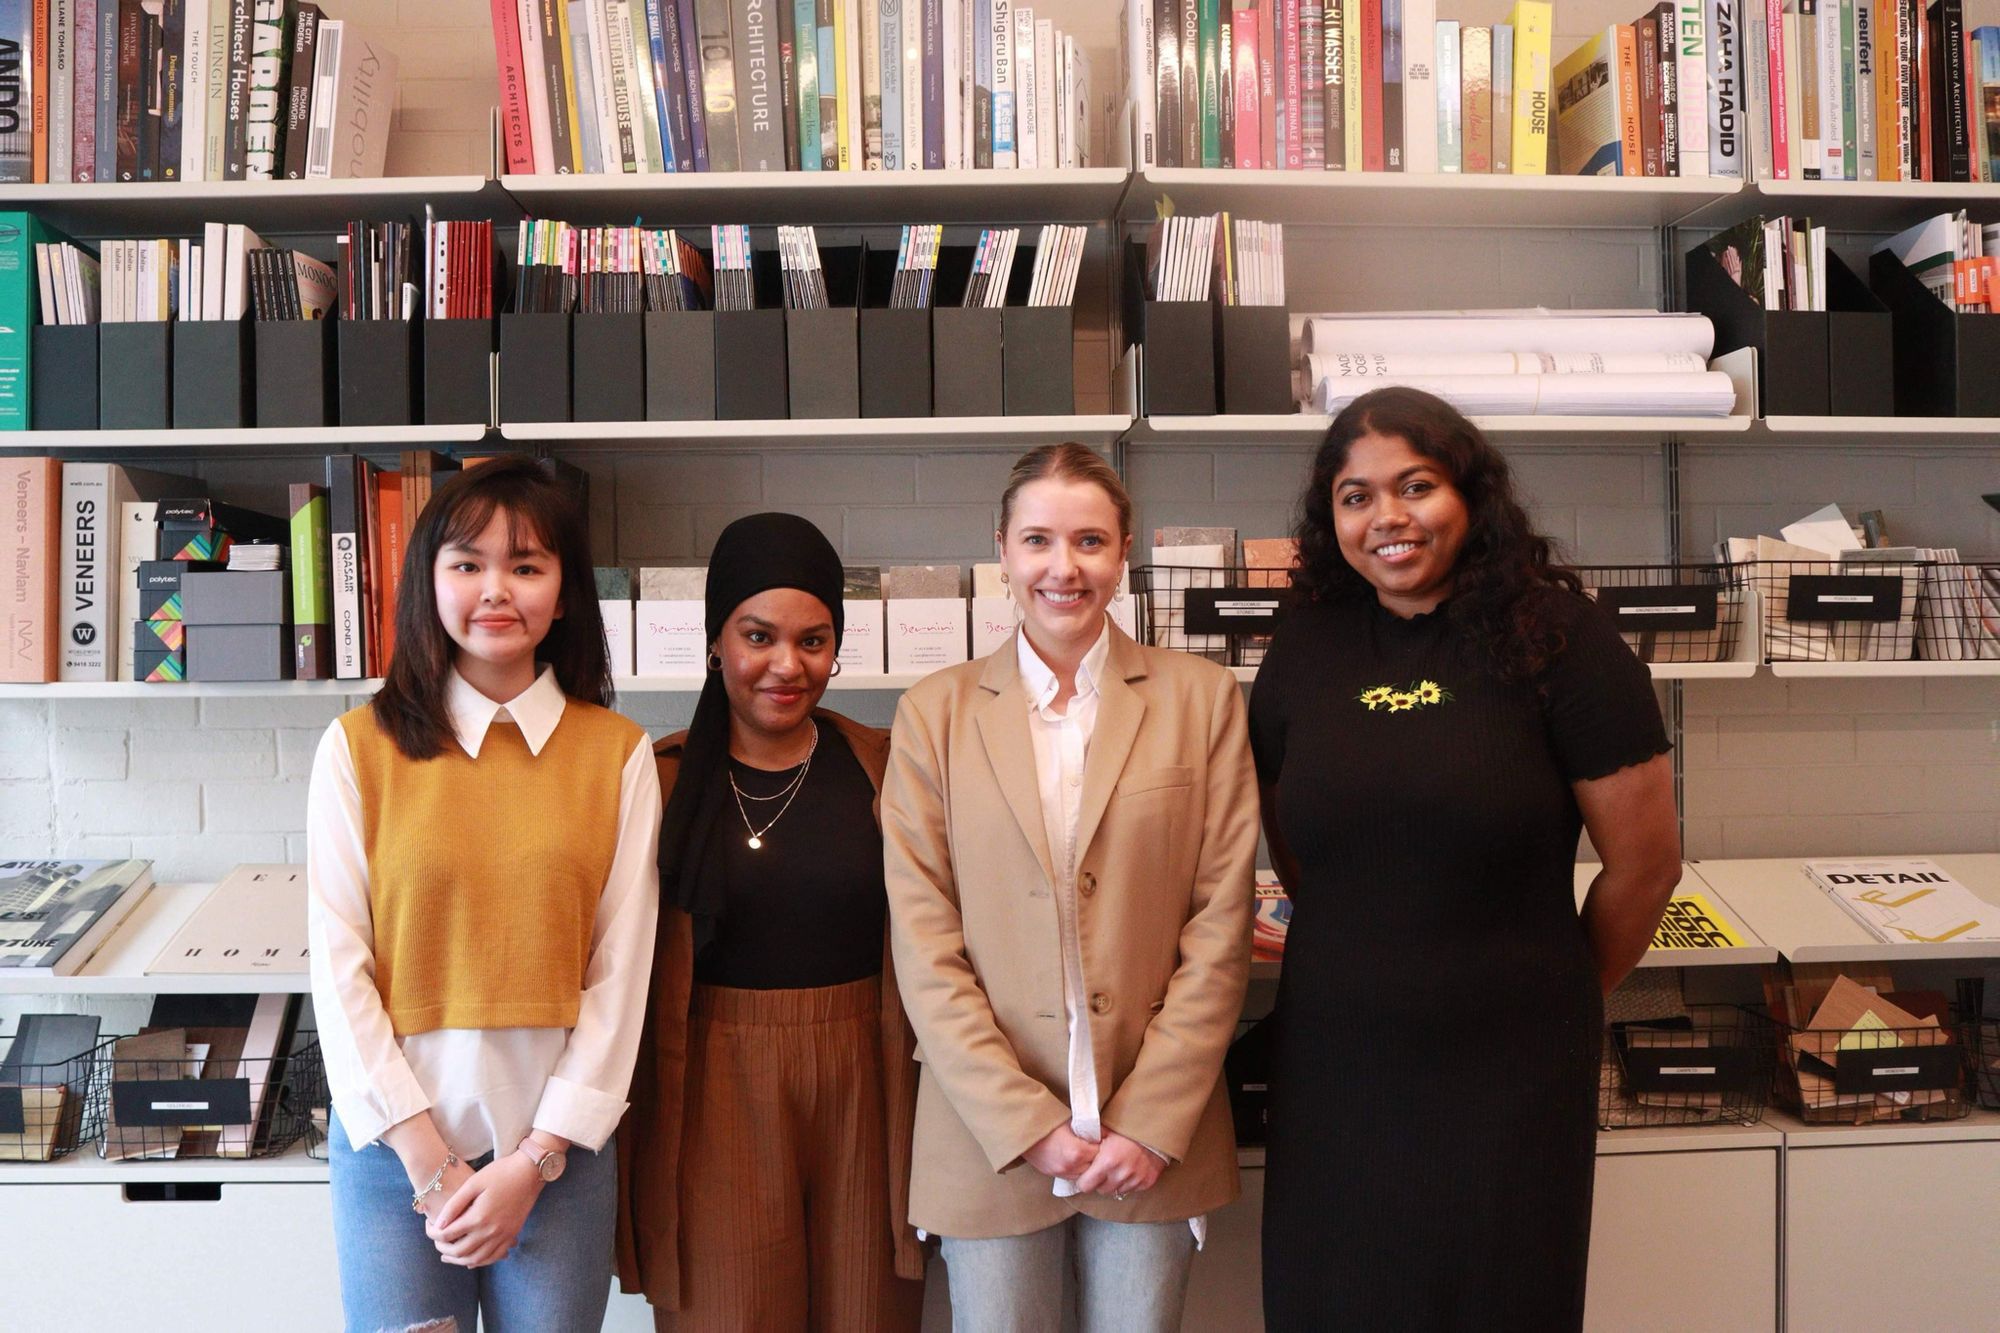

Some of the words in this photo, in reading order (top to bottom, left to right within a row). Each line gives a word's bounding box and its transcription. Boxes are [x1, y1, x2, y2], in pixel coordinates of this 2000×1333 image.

[104, 13, 113, 47] Beautiful
[296, 11, 305, 52] GARDENER
[304, 29, 312, 45] CITY
[650, 16, 660, 40] SMALL
[668, 5, 677, 43] COASTAL
[993, 1, 1008, 56] Shigeru
[1288, 31, 1297, 41] AT
[1681, 1, 1703, 56] TEN
[1717, 2, 1733, 74] ZAHA
[1827, 16, 1836, 49] building
[1950, 20, 1958, 28] A
[1288, 45, 1297, 61] THE
[1349, 35, 1357, 54] ahead
[1858, 7, 1872, 76] neufert
[1900, 41, 1909, 62] YOUR
[1951, 31, 1959, 68] HISTORY
[104, 49, 113, 71] Beach
[168, 55, 177, 81] Design
[672, 45, 681, 73] HOMES
[747, 0, 769, 132] RCHITECTURE
[996, 59, 1008, 83] Ban
[1900, 65, 1909, 84] OWN
[688, 69, 697, 93] BEACH
[1289, 64, 1298, 95] VENICE
[1828, 51, 1837, 101] construction
[168, 83, 176, 122] Commune
[230, 70, 245, 121] Houses
[290, 86, 299, 130] UNSWORTH
[298, 87, 307, 119] RICHARD
[506, 65, 522, 147] ARCHITECTS
[615, 86, 631, 129] HOUSE
[691, 95, 699, 122] HOUSES
[1330, 89, 1339, 130] ARCHITECTURE
[1349, 88, 1357, 111] century
[1670, 92, 1676, 103] OF
[1901, 86, 1909, 108] HOME
[1289, 99, 1298, 140] BIENNALE
[1531, 92, 1546, 135] HOUSE
[1719, 79, 1735, 157] HADID
[1830, 102, 1839, 141] illustrated
[1953, 82, 1962, 145] ARCHITECTURE
[1627, 117, 1635, 156] HOUSE
[114, 248, 122, 272] habitus
[127, 248, 135, 272] habitus
[139, 249, 148, 272] habitus
[16, 470, 32, 532] Veneers
[165, 508, 194, 516] polytec
[75, 500, 95, 612] VENEERS
[343, 552, 354, 593] QASAIR
[15, 547, 31, 603] Navlam
[149, 576, 177, 584] polytec
[1827, 872, 1950, 885] DETAIL
[1652, 931, 1734, 948] Milan
